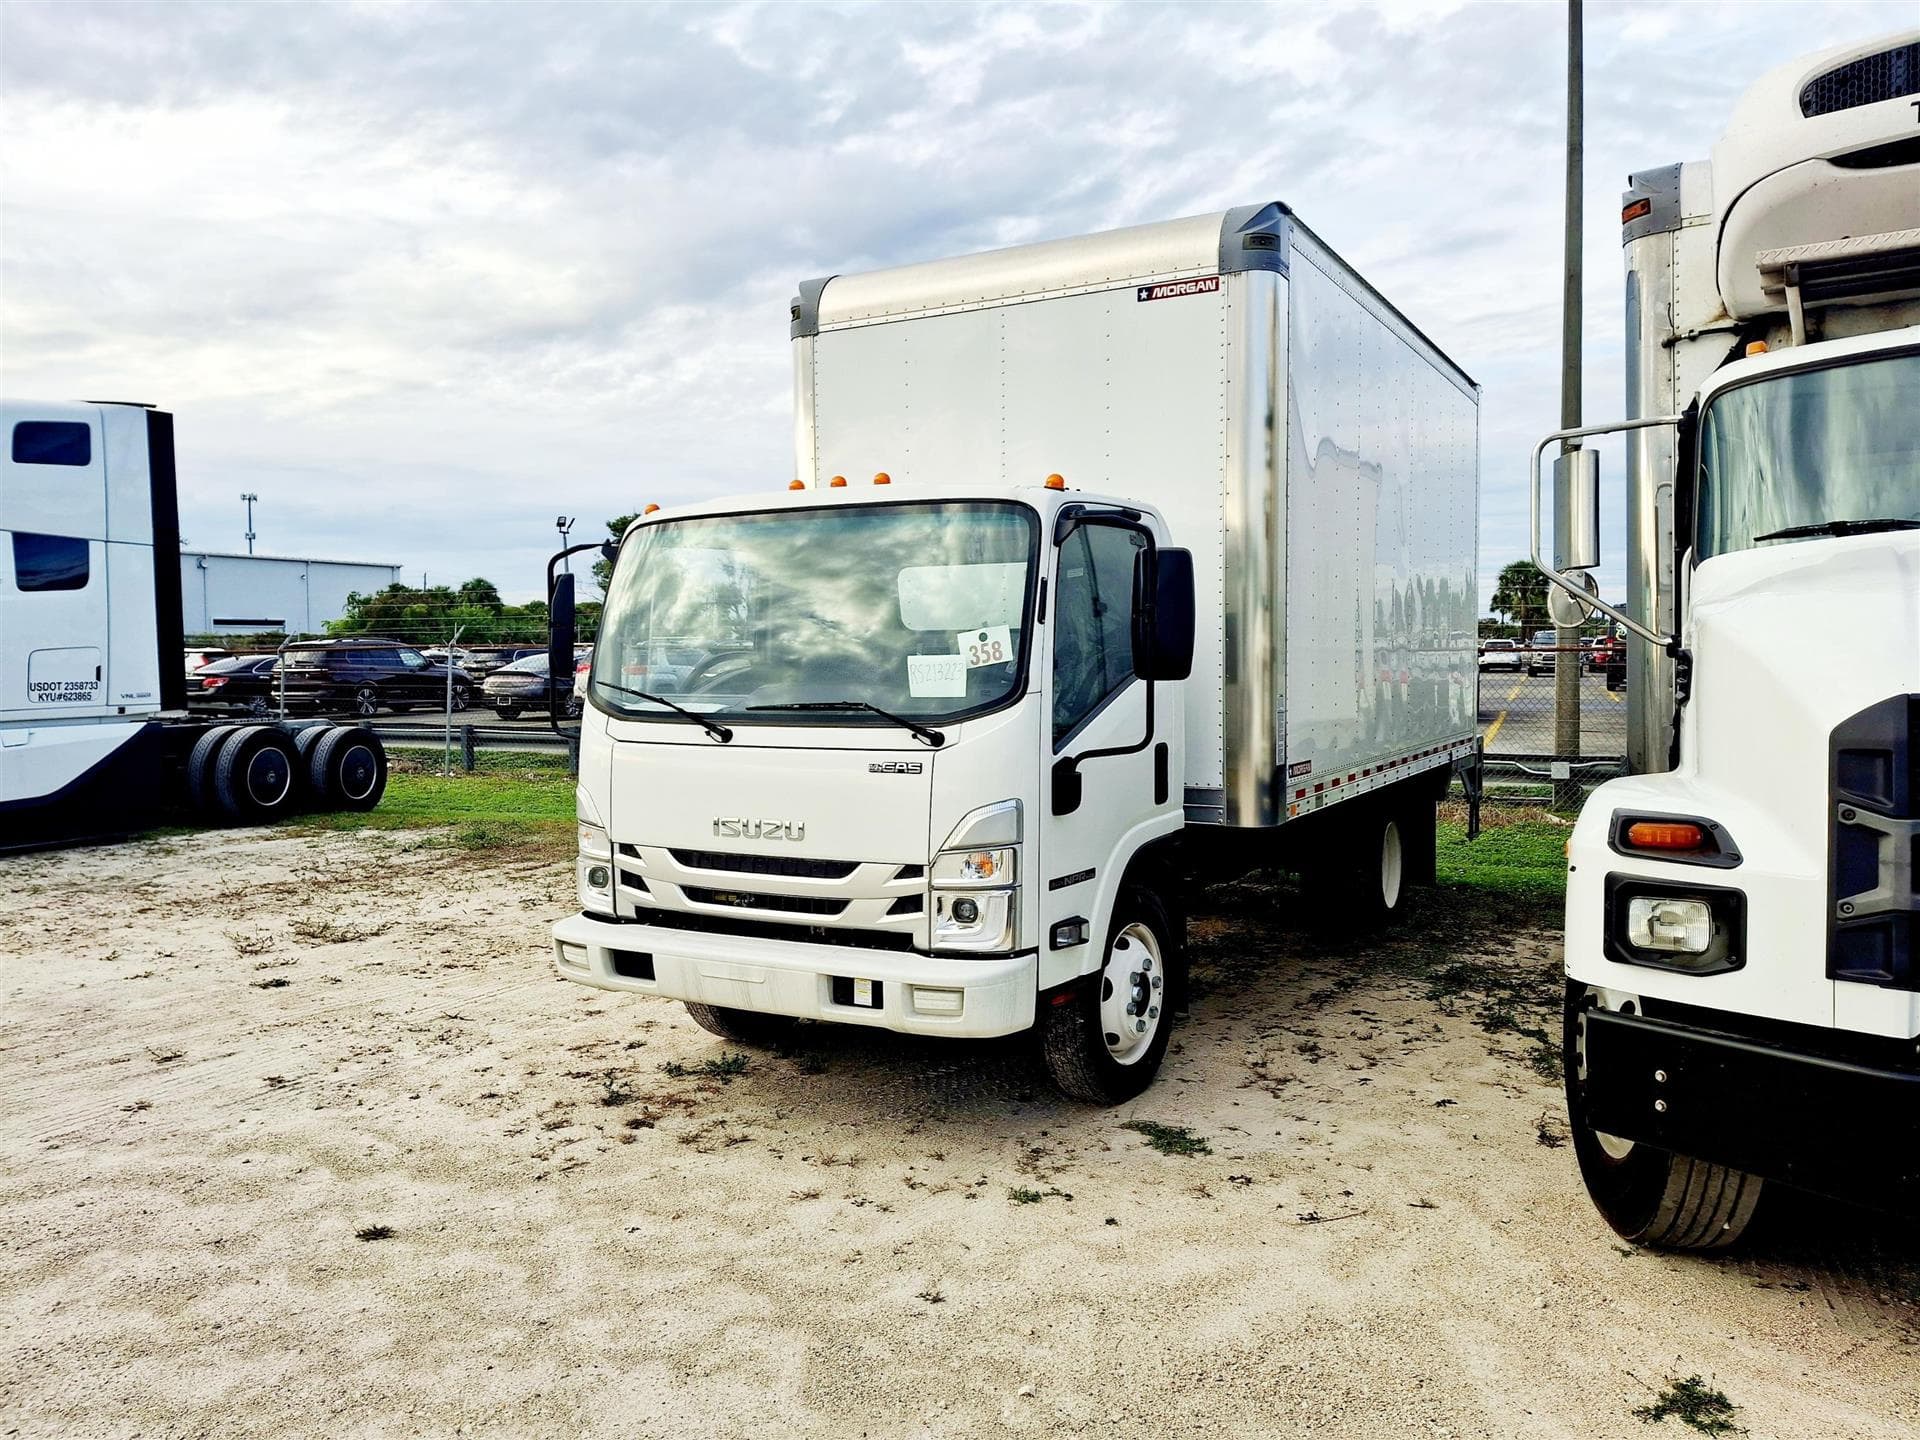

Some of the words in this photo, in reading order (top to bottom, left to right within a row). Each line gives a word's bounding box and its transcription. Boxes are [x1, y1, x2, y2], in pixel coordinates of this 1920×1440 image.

[1152, 279, 1216, 298] MORGAN
[969, 641, 1003, 665] 358
[29, 682, 62, 692] USDOT
[64, 681, 99, 691] 2358733
[882, 762, 922, 774] GAS
[713, 816, 805, 841] ISUZU
